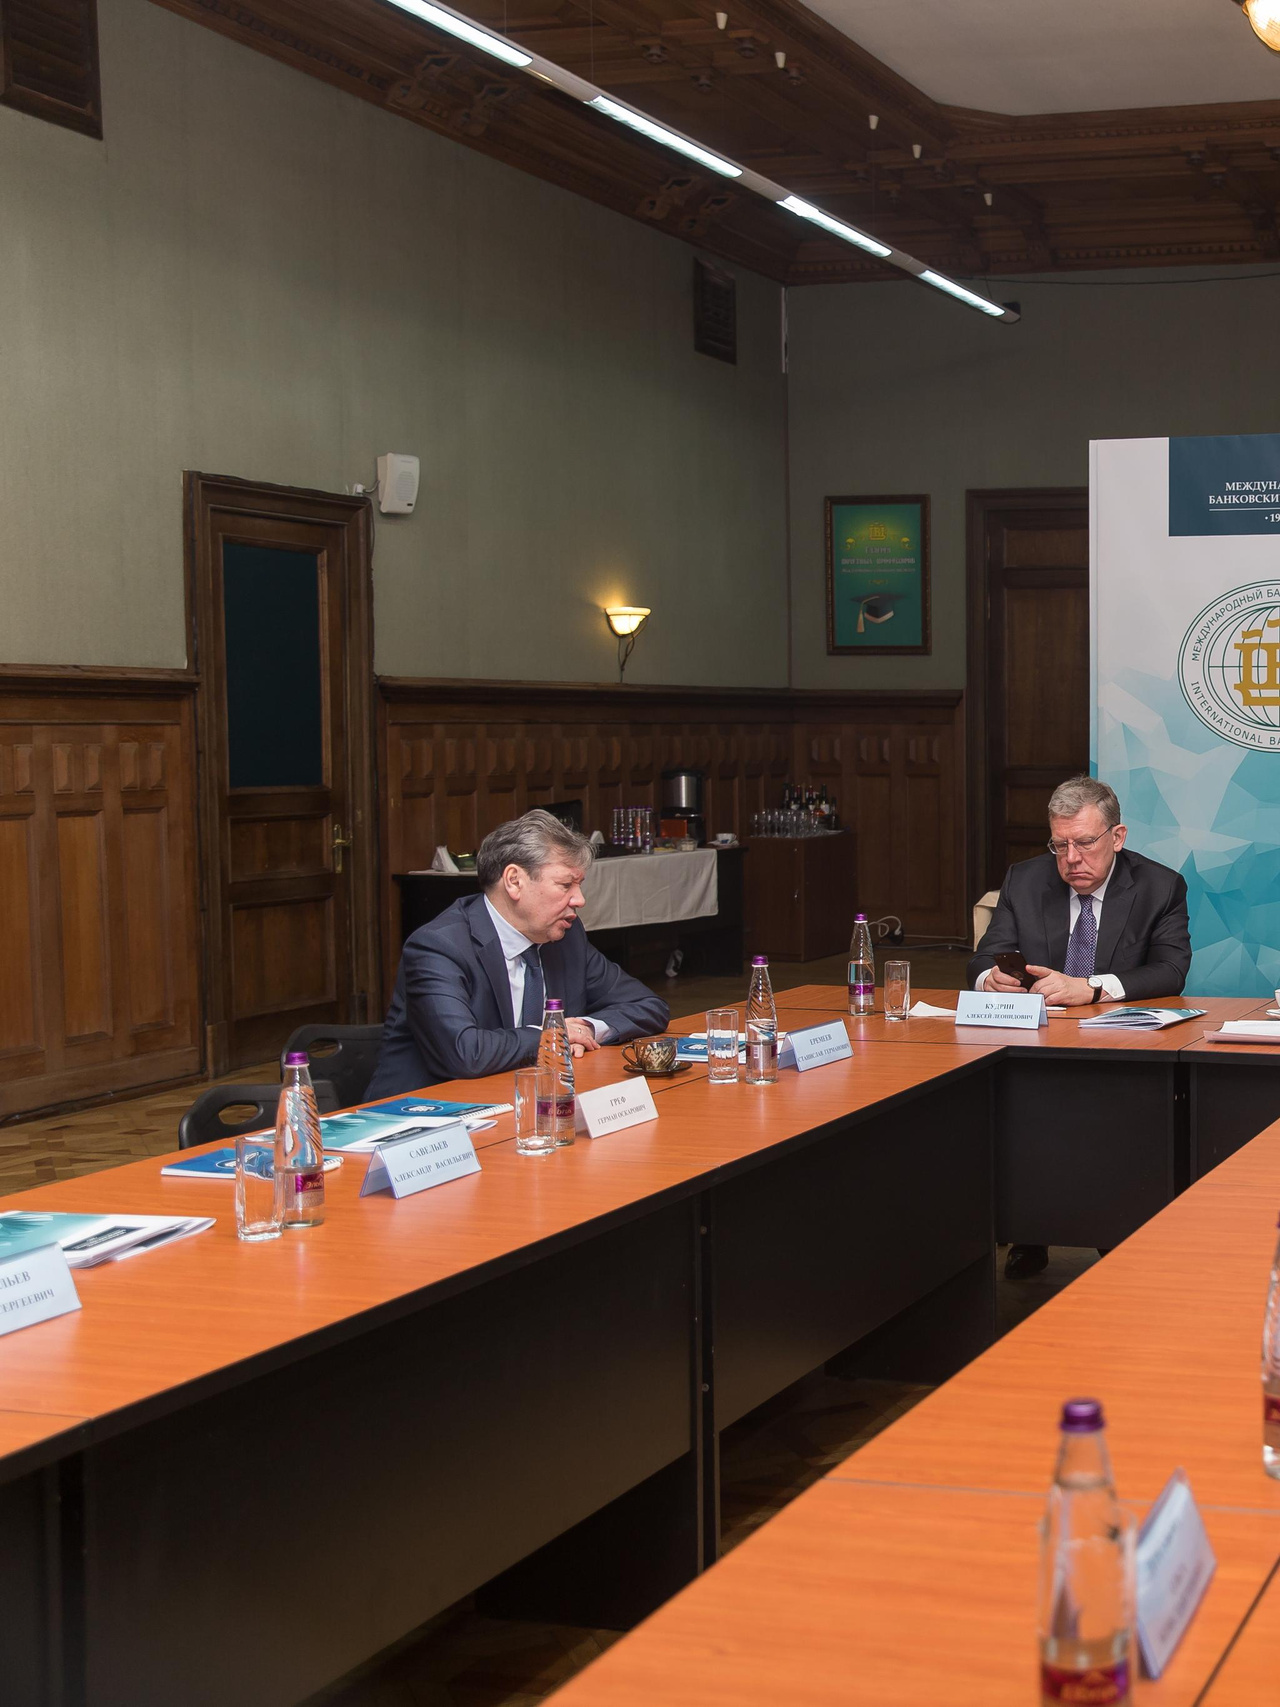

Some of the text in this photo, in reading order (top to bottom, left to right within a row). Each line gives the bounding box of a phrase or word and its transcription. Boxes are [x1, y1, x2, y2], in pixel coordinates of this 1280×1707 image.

[1191, 588, 1263, 662] МЕЖДУНАРОДНЫЙ
[1191, 681, 1263, 744] INTERNATIONAL
[609, 1096, 627, 1107] ГРЕФ
[597, 1113, 618, 1125] ГЕРМАН
[409, 1140, 449, 1159] САВЕЛЬЕВ
[394, 1151, 474, 1183] АЛЕКСАНДР ВАСИЛЬЕВИЧ
